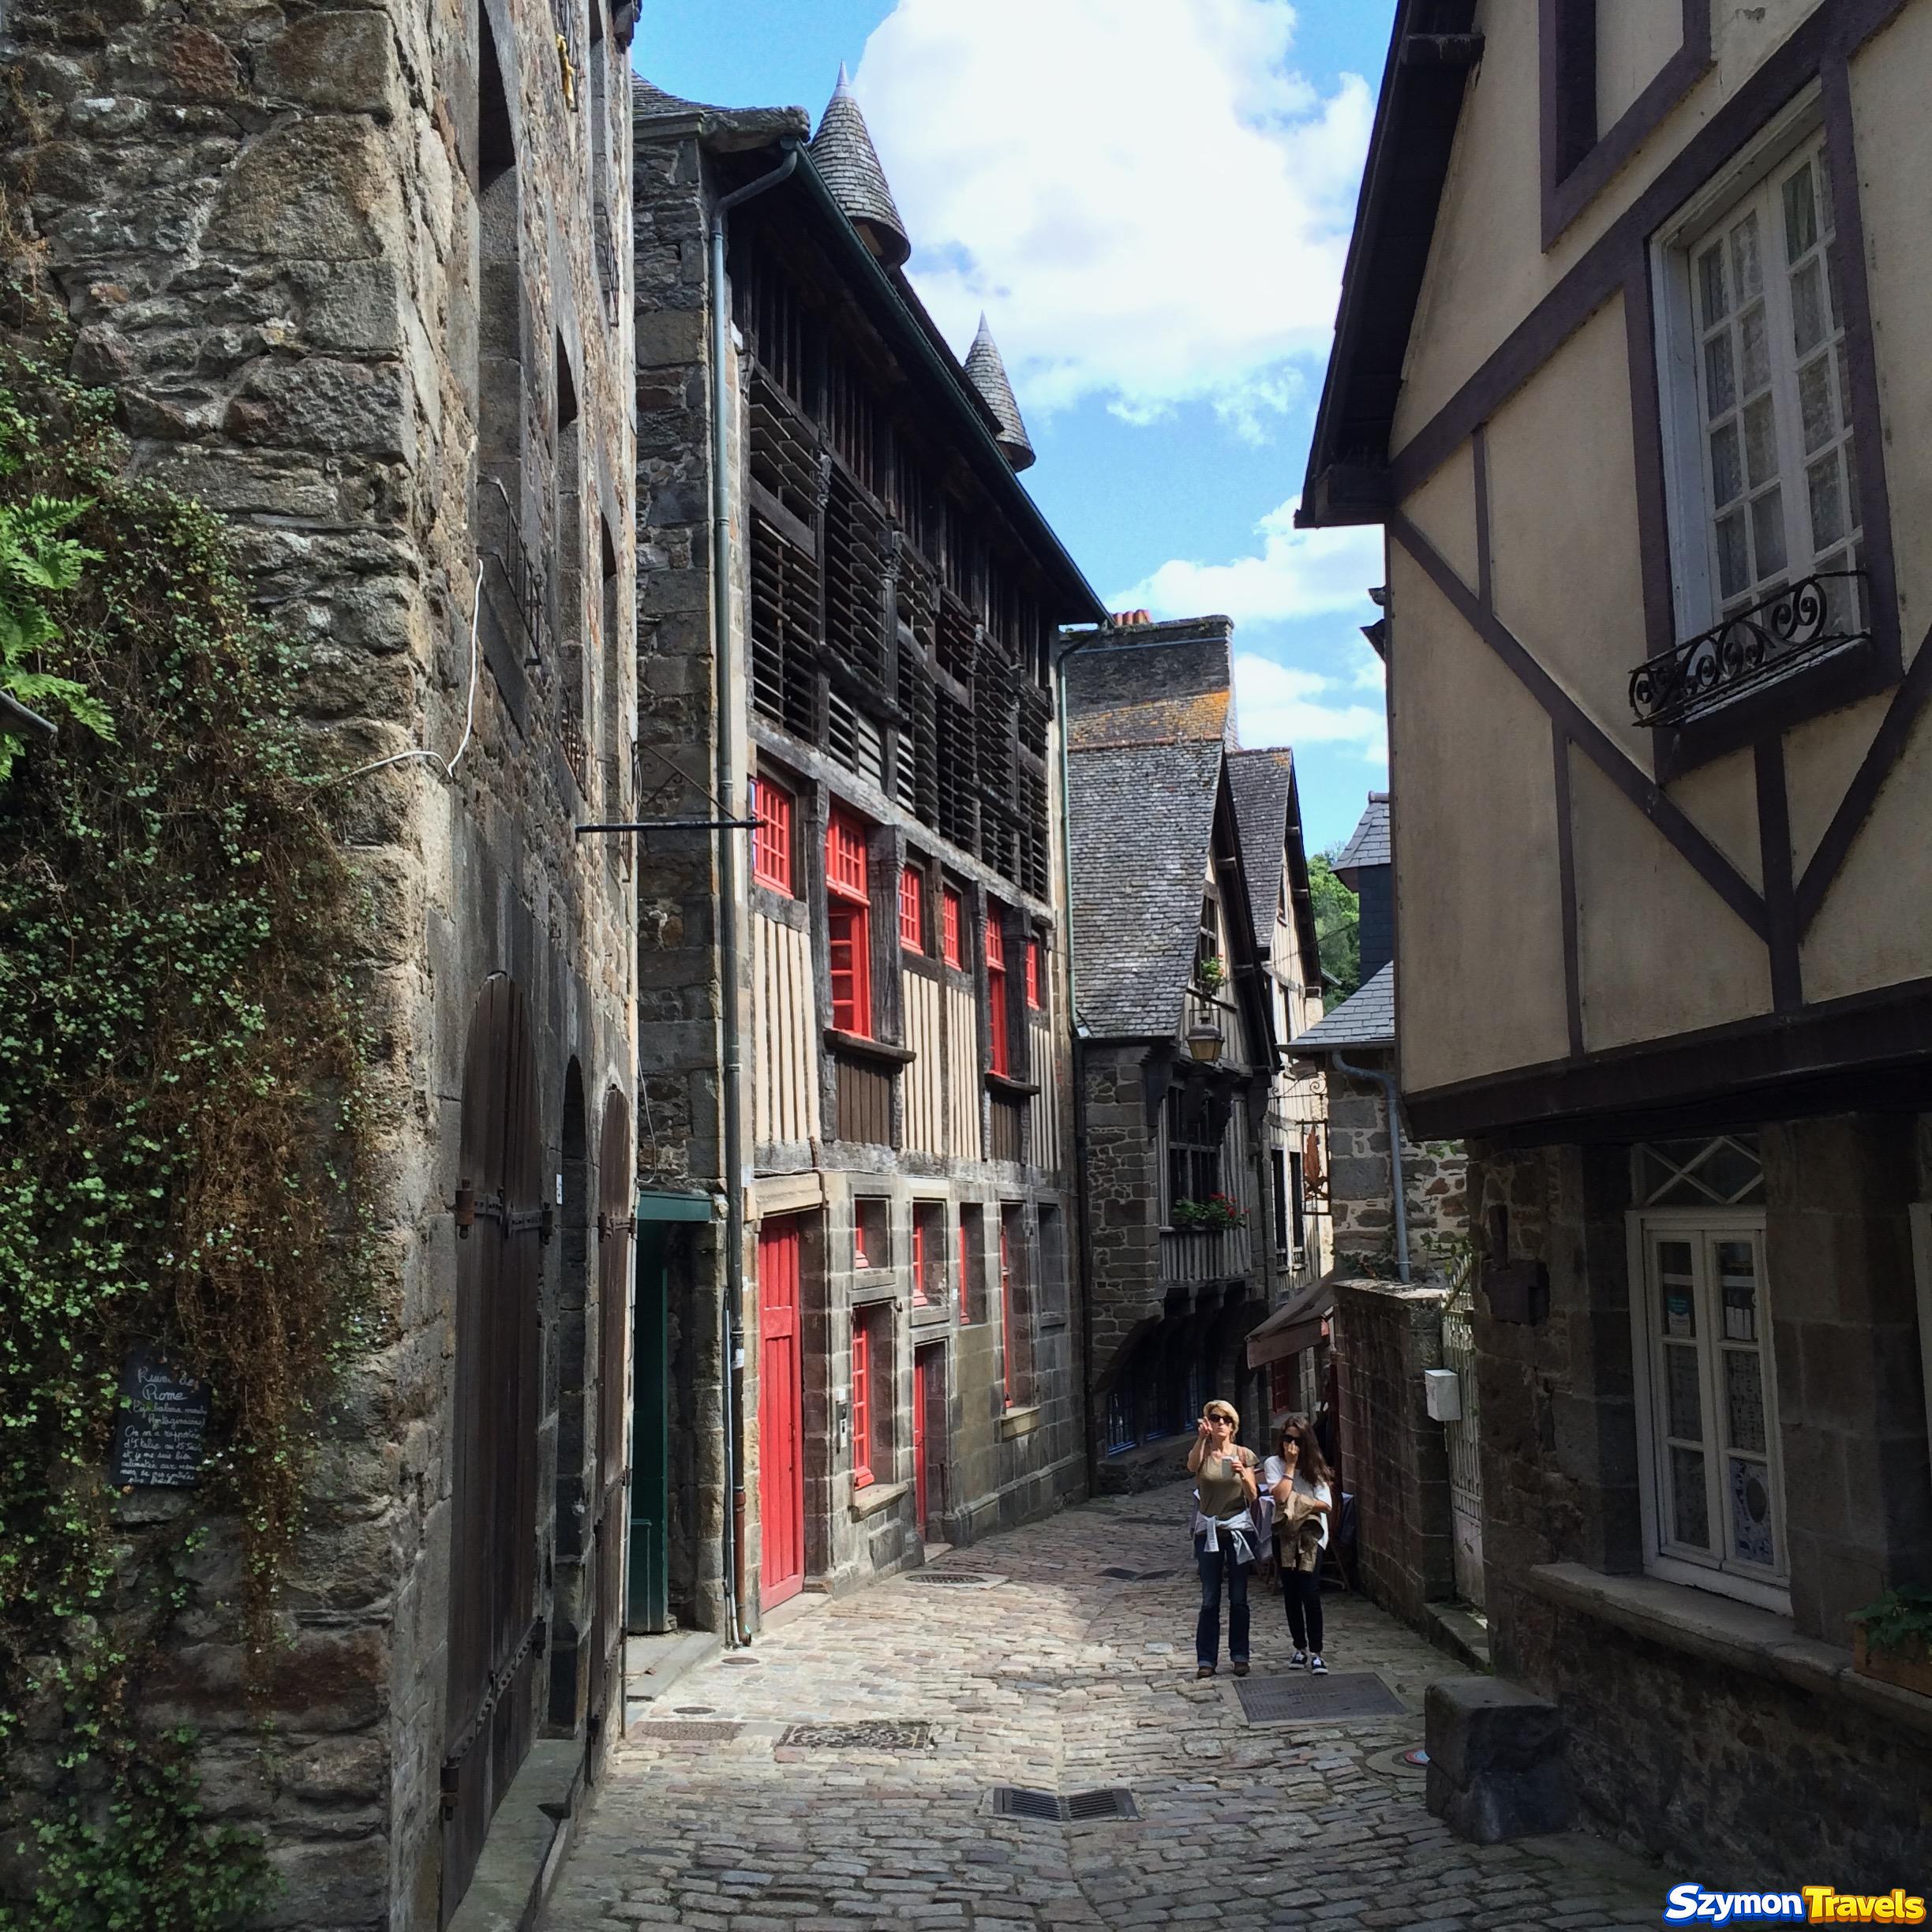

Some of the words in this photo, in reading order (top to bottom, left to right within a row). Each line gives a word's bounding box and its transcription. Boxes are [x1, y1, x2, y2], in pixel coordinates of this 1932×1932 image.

[142, 1383, 188, 1401] Rome
[125, 1425, 138, 1437] On
[122, 1449, 133, 1458] et
